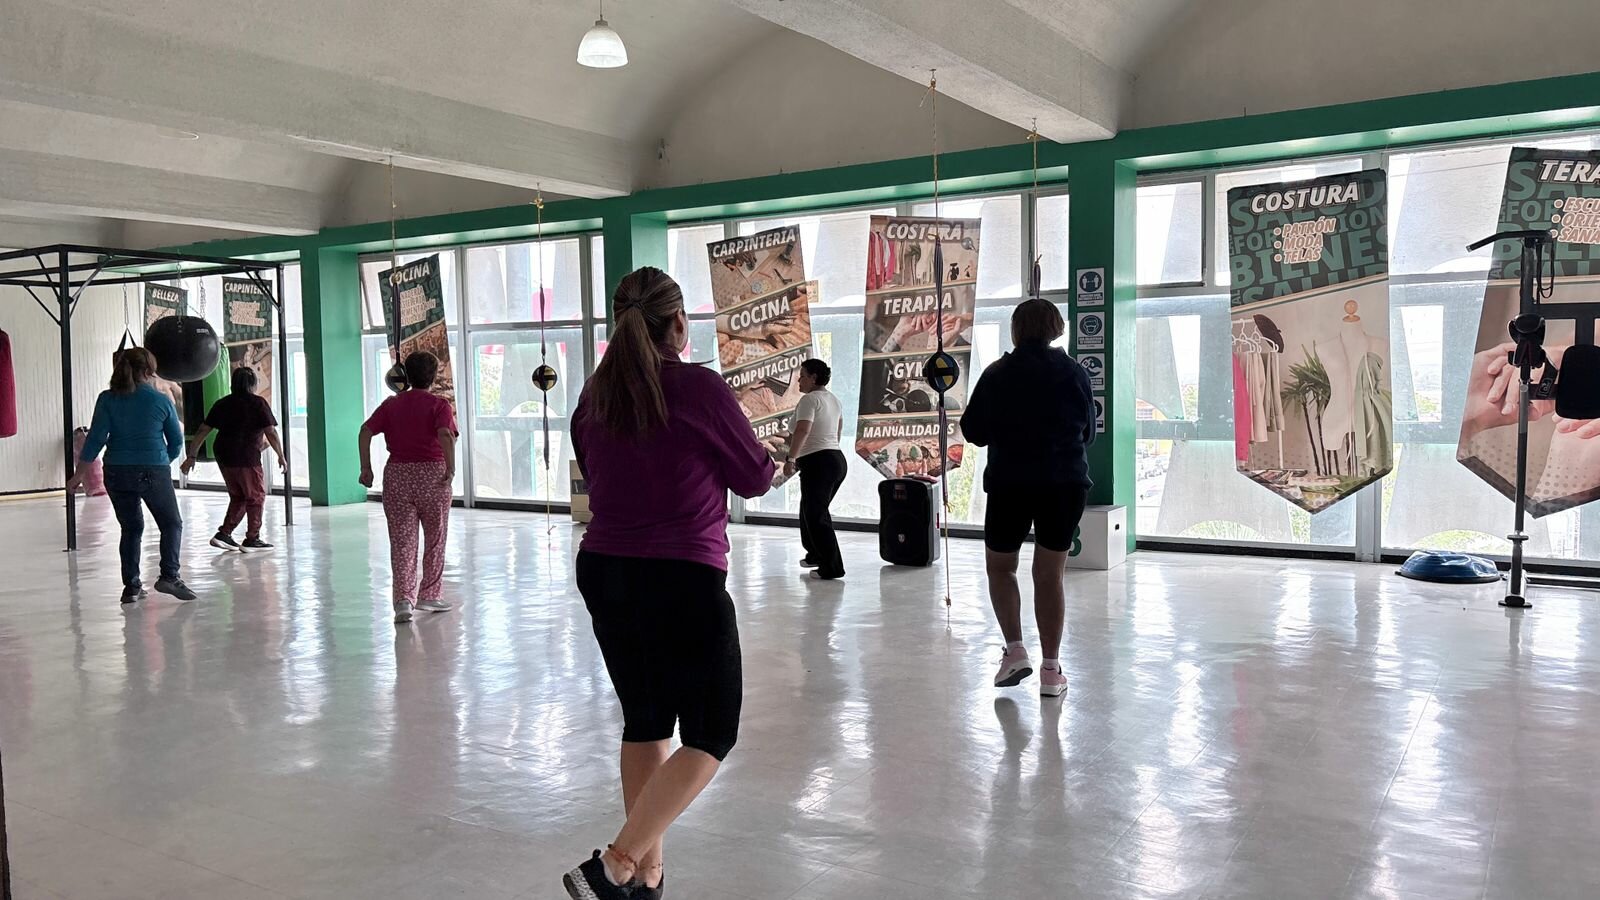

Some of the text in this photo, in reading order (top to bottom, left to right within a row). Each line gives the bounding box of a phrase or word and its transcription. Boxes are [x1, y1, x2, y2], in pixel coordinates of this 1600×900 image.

[1251, 182, 1359, 213] COSTURA
[886, 223, 962, 241] COSTURA
[1282, 216, 1336, 237] PATRÓN
[712, 228, 796, 258] CARPINTERIA
[1283, 234, 1323, 250] MODA
[1284, 249, 1322, 264] TELAS
[389, 261, 431, 287] COCINA
[152, 288, 180, 303] BELLEZA
[224, 282, 271, 294] CARPINTE
[883, 292, 953, 315] TERAPIA
[730, 295, 790, 332] COCINA
[725, 352, 807, 388] COMPUTACION
[782, 416, 792, 431] S
[863, 423, 955, 438] MANUALIDADS
